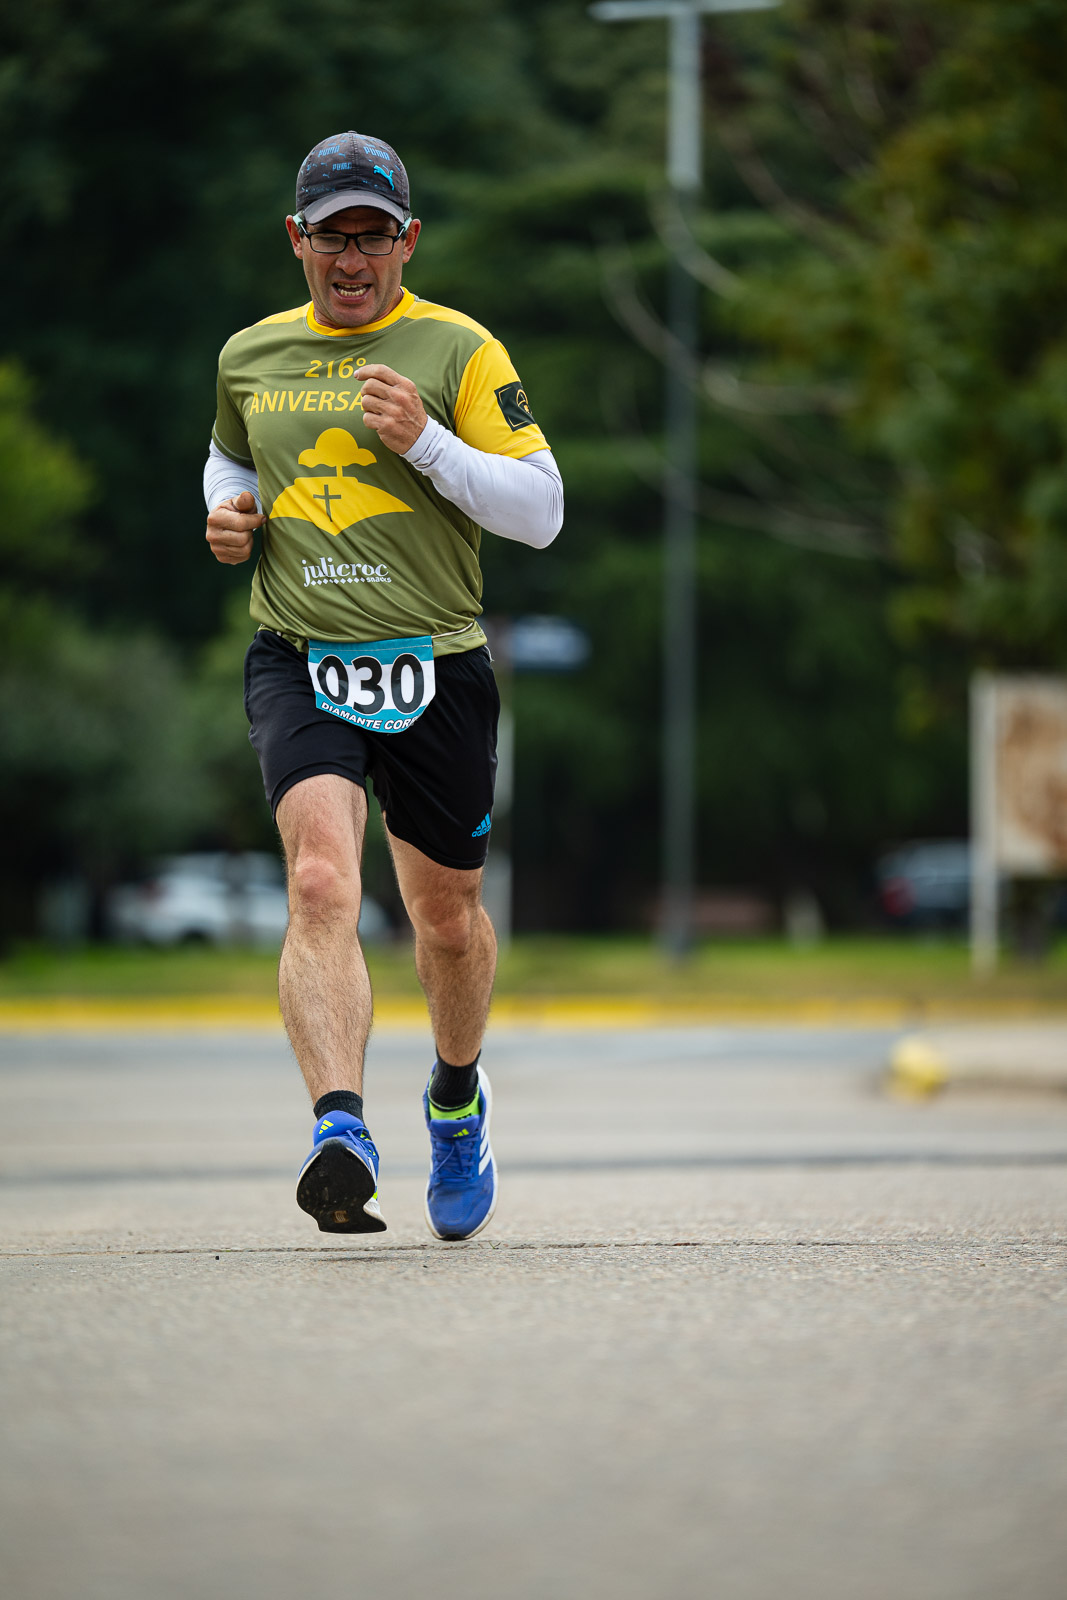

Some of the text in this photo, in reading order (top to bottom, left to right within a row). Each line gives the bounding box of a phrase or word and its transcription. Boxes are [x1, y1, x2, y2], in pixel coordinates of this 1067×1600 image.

[318, 145, 340, 157] PUMA
[363, 146, 391, 160] PUMA
[305, 357, 366, 379] 216°
[301, 557, 389, 588] julicroc
[316, 653, 425, 716] 030
[321, 702, 382, 730] DIAMANTE
